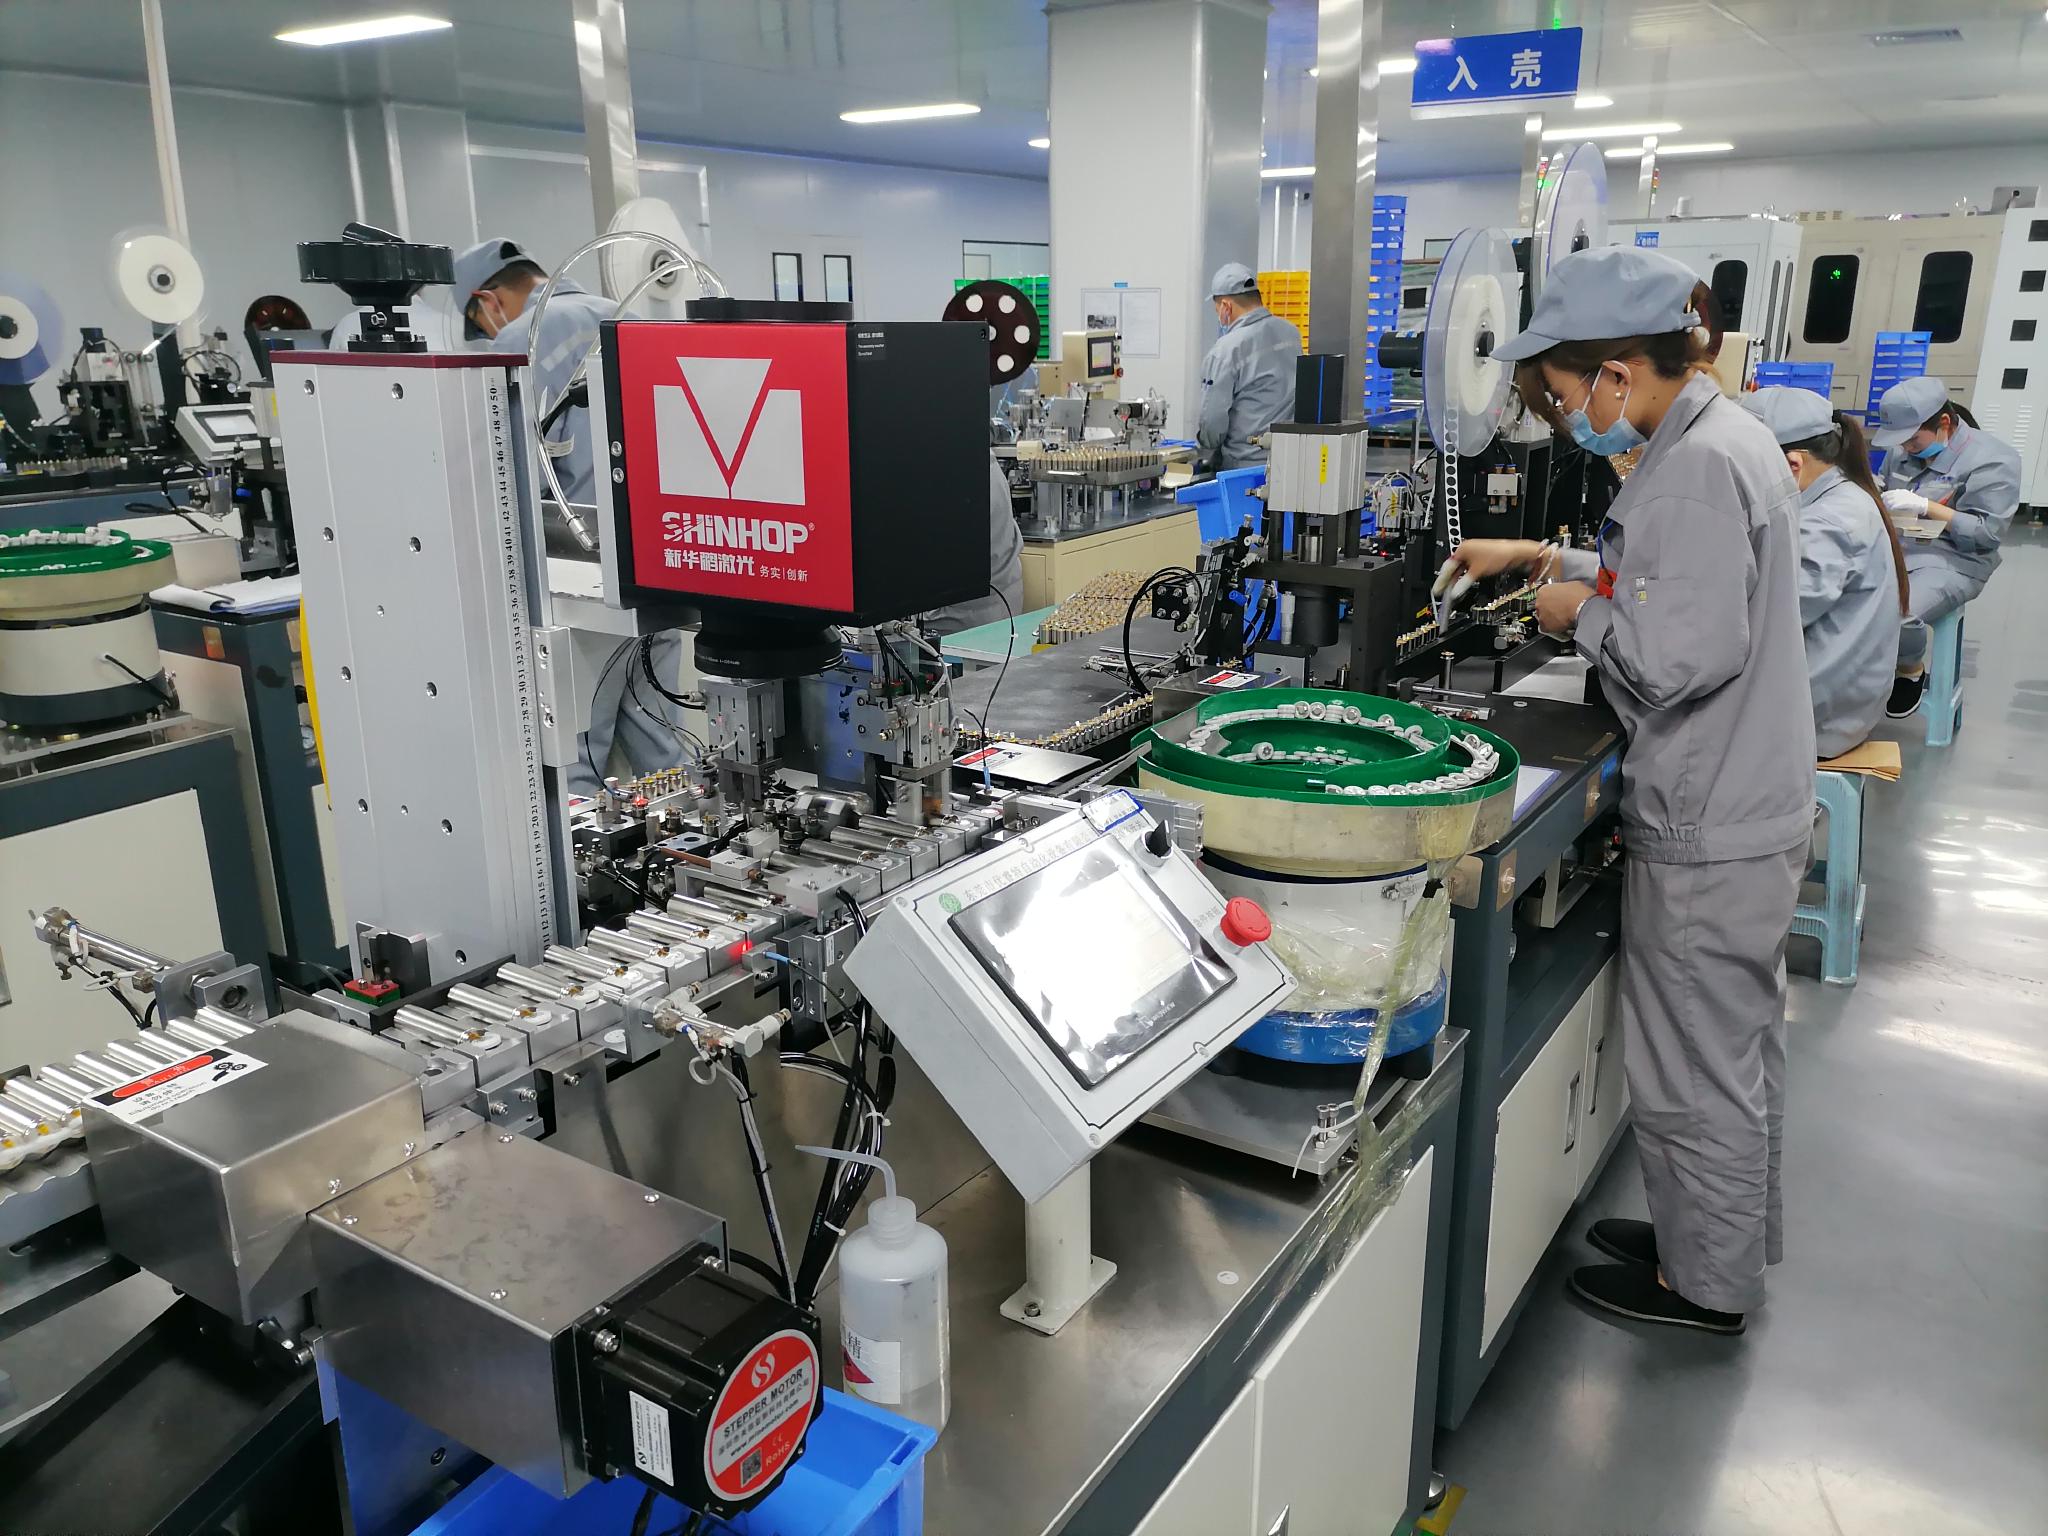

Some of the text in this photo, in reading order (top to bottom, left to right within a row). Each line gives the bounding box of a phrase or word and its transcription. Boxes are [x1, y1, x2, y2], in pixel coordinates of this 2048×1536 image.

[1447, 49, 1542, 92] 入壳
[490, 388, 498, 401] 50
[492, 405, 499, 416] 49
[494, 420, 501, 431] 48
[495, 436, 502, 447] 47
[497, 451, 504, 462] 46
[498, 466, 505, 477] 45
[500, 481, 506, 492] 44
[501, 496, 508, 507] 43
[503, 511, 510, 521] 42
[504, 526, 511, 536] 41
[505, 539, 512, 551] 40
[507, 555, 514, 566] 39
[509, 569, 515, 580] 38
[510, 584, 517, 595] 37
[512, 598, 519, 609] 36
[513, 612, 519, 623] 35
[514, 626, 521, 637] 34
[515, 641, 522, 651] 33
[517, 655, 524, 665] 32
[518, 669, 525, 679] 31
[518, 681, 526, 693] 30
[521, 697, 528, 707] 29
[522, 709, 529, 720] 28
[524, 725, 531, 734] 27
[525, 737, 532, 748] 26
[526, 750, 533, 761] 25
[527, 764, 534, 774] 24
[529, 777, 536, 788] 23
[530, 790, 536, 801] 22
[531, 805, 538, 814] 21
[532, 815, 539, 828] 20
[533, 830, 540, 840] 19
[534, 843, 541, 853] 18
[536, 857, 542, 867] 17
[537, 869, 543, 879] 16
[538, 882, 545, 892] 15
[539, 894, 546, 904] 14
[540, 907, 548, 917] 13
[542, 920, 549, 930] 12
[542, 933, 549, 942] 11
[723, 1397, 768, 1438] STEPPER
[770, 1368, 803, 1400] MOTOR
